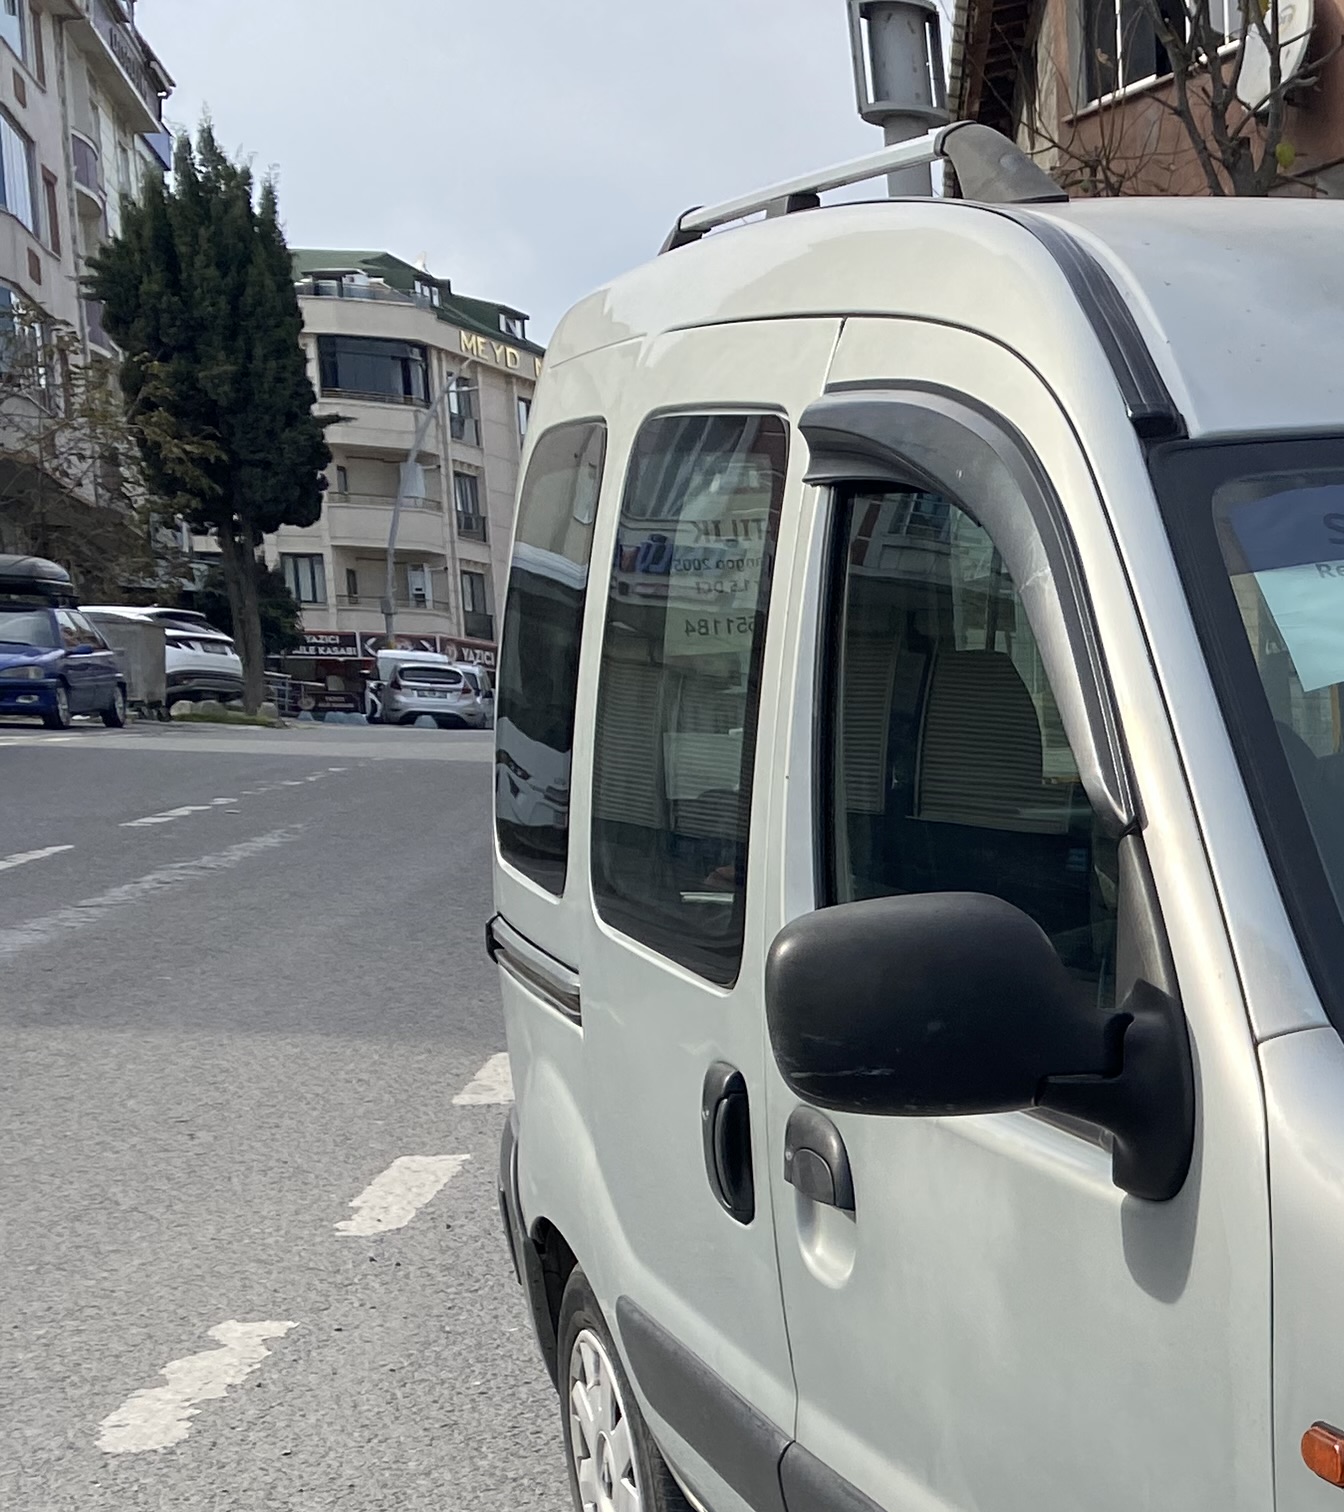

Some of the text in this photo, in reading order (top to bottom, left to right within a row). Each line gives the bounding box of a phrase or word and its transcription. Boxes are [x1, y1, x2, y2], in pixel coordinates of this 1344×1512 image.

[459, 329, 520, 369] MEYD
[304, 634, 340, 644] YAZICI
[461, 647, 495, 666] YAZICI
